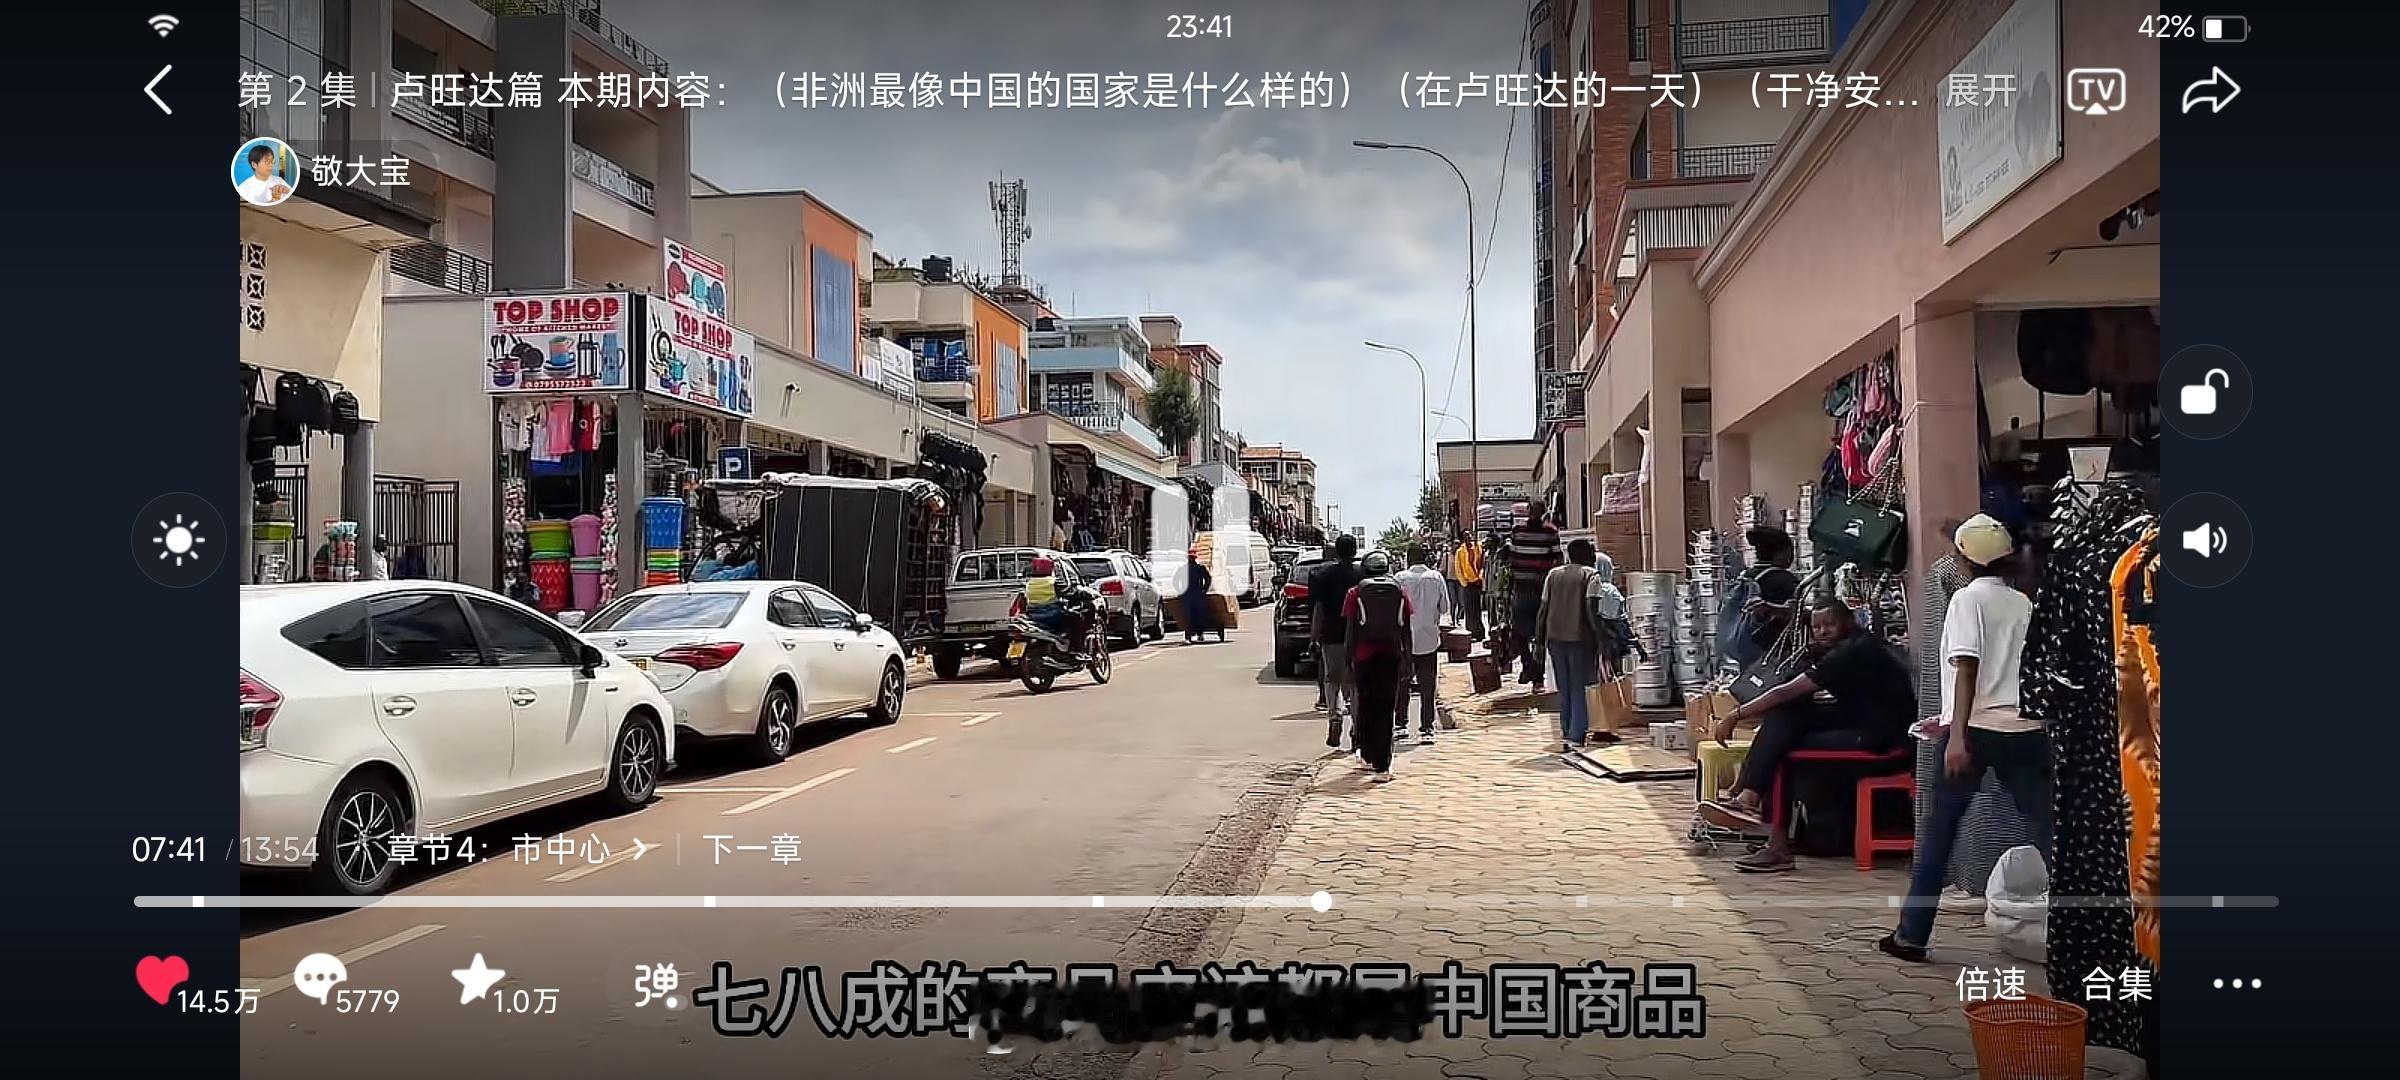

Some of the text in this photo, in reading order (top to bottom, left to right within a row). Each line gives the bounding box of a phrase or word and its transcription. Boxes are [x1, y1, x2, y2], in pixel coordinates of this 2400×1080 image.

[493, 297, 620, 325] TOP SHOP
[674, 310, 698, 339] TOP
[702, 320, 733, 352] SHOP
[725, 457, 742, 481] P
